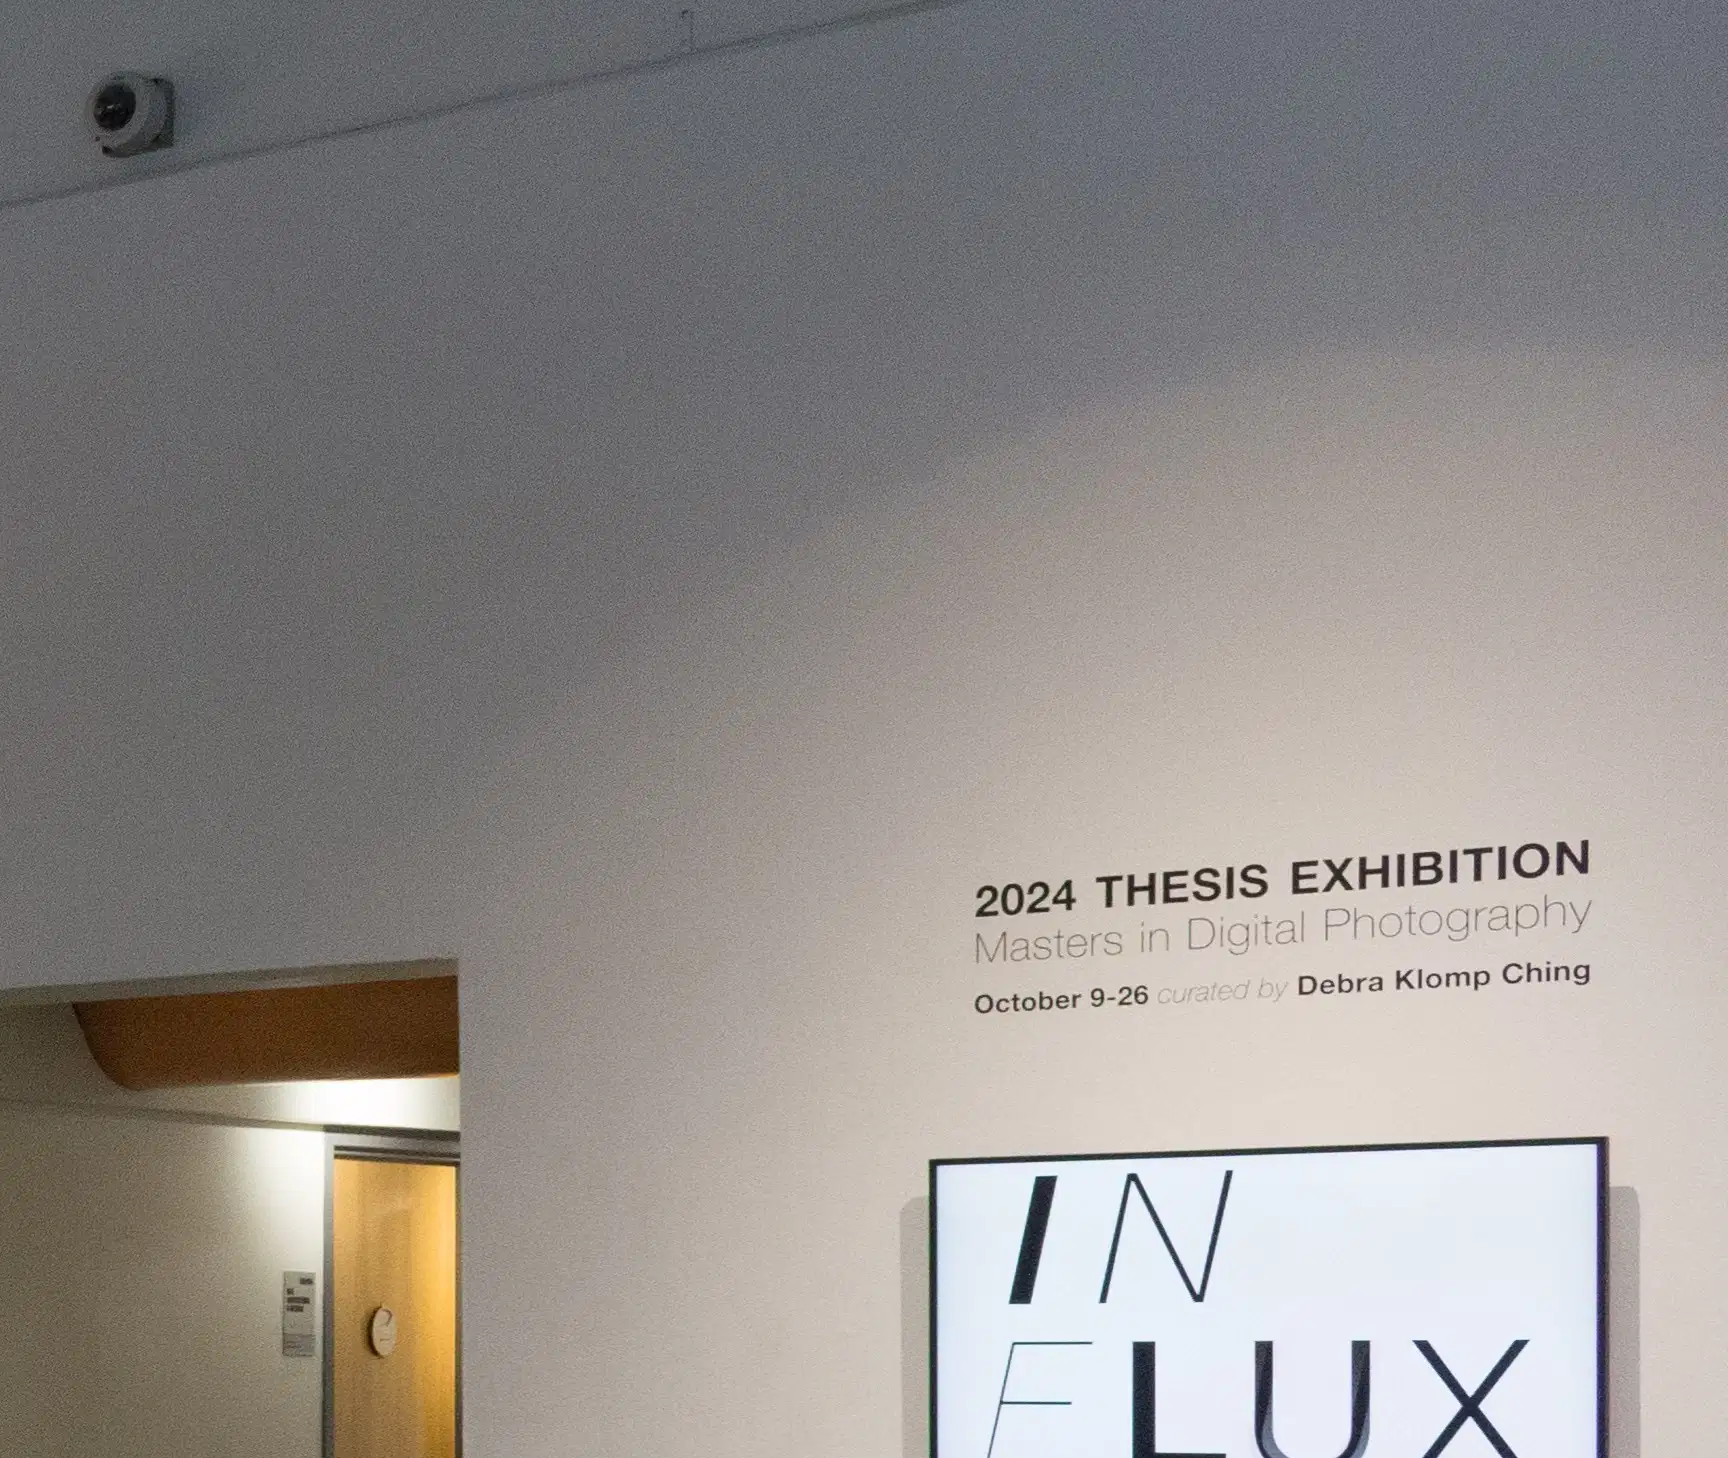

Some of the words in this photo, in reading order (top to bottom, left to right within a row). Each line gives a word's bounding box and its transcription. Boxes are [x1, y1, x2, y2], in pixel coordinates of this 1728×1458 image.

[975, 881, 1077, 918] 2024
[1095, 864, 1269, 909] THESIS
[1291, 839, 1590, 896] EXHIBITION
[975, 928, 1124, 965] Masters
[1140, 921, 1170, 954] in
[1187, 910, 1306, 956] Digital
[1324, 894, 1593, 944] Photography
[974, 989, 1082, 1014] October
[1090, 985, 1149, 1008] 9-26
[1157, 979, 1251, 1005] curated
[1258, 977, 1289, 1003] by
[1298, 973, 1384, 996] Debra
[1395, 968, 1491, 991] Klomp
[1502, 961, 1591, 986] Ching
[1008, 1169, 1234, 1305] IN
